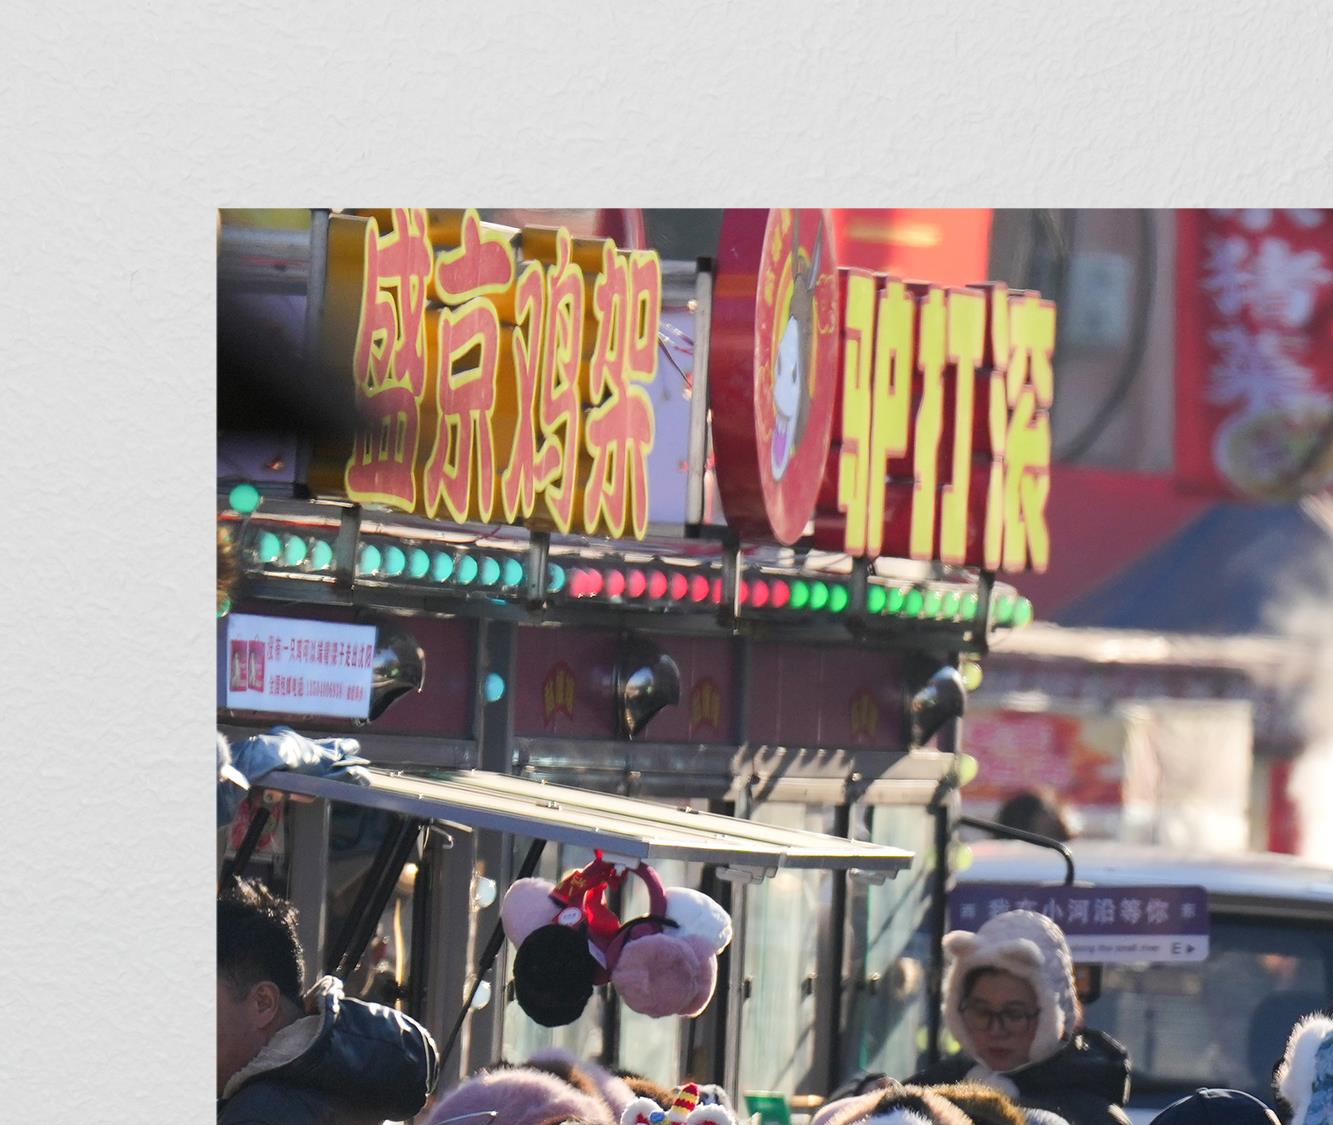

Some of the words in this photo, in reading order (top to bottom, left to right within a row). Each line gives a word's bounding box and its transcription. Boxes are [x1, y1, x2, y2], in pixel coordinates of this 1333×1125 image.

[344, 208, 661, 540] 盛京鸡架
[838, 266, 1057, 573] 驴打滚
[1171, 942, 1182, 954] E
